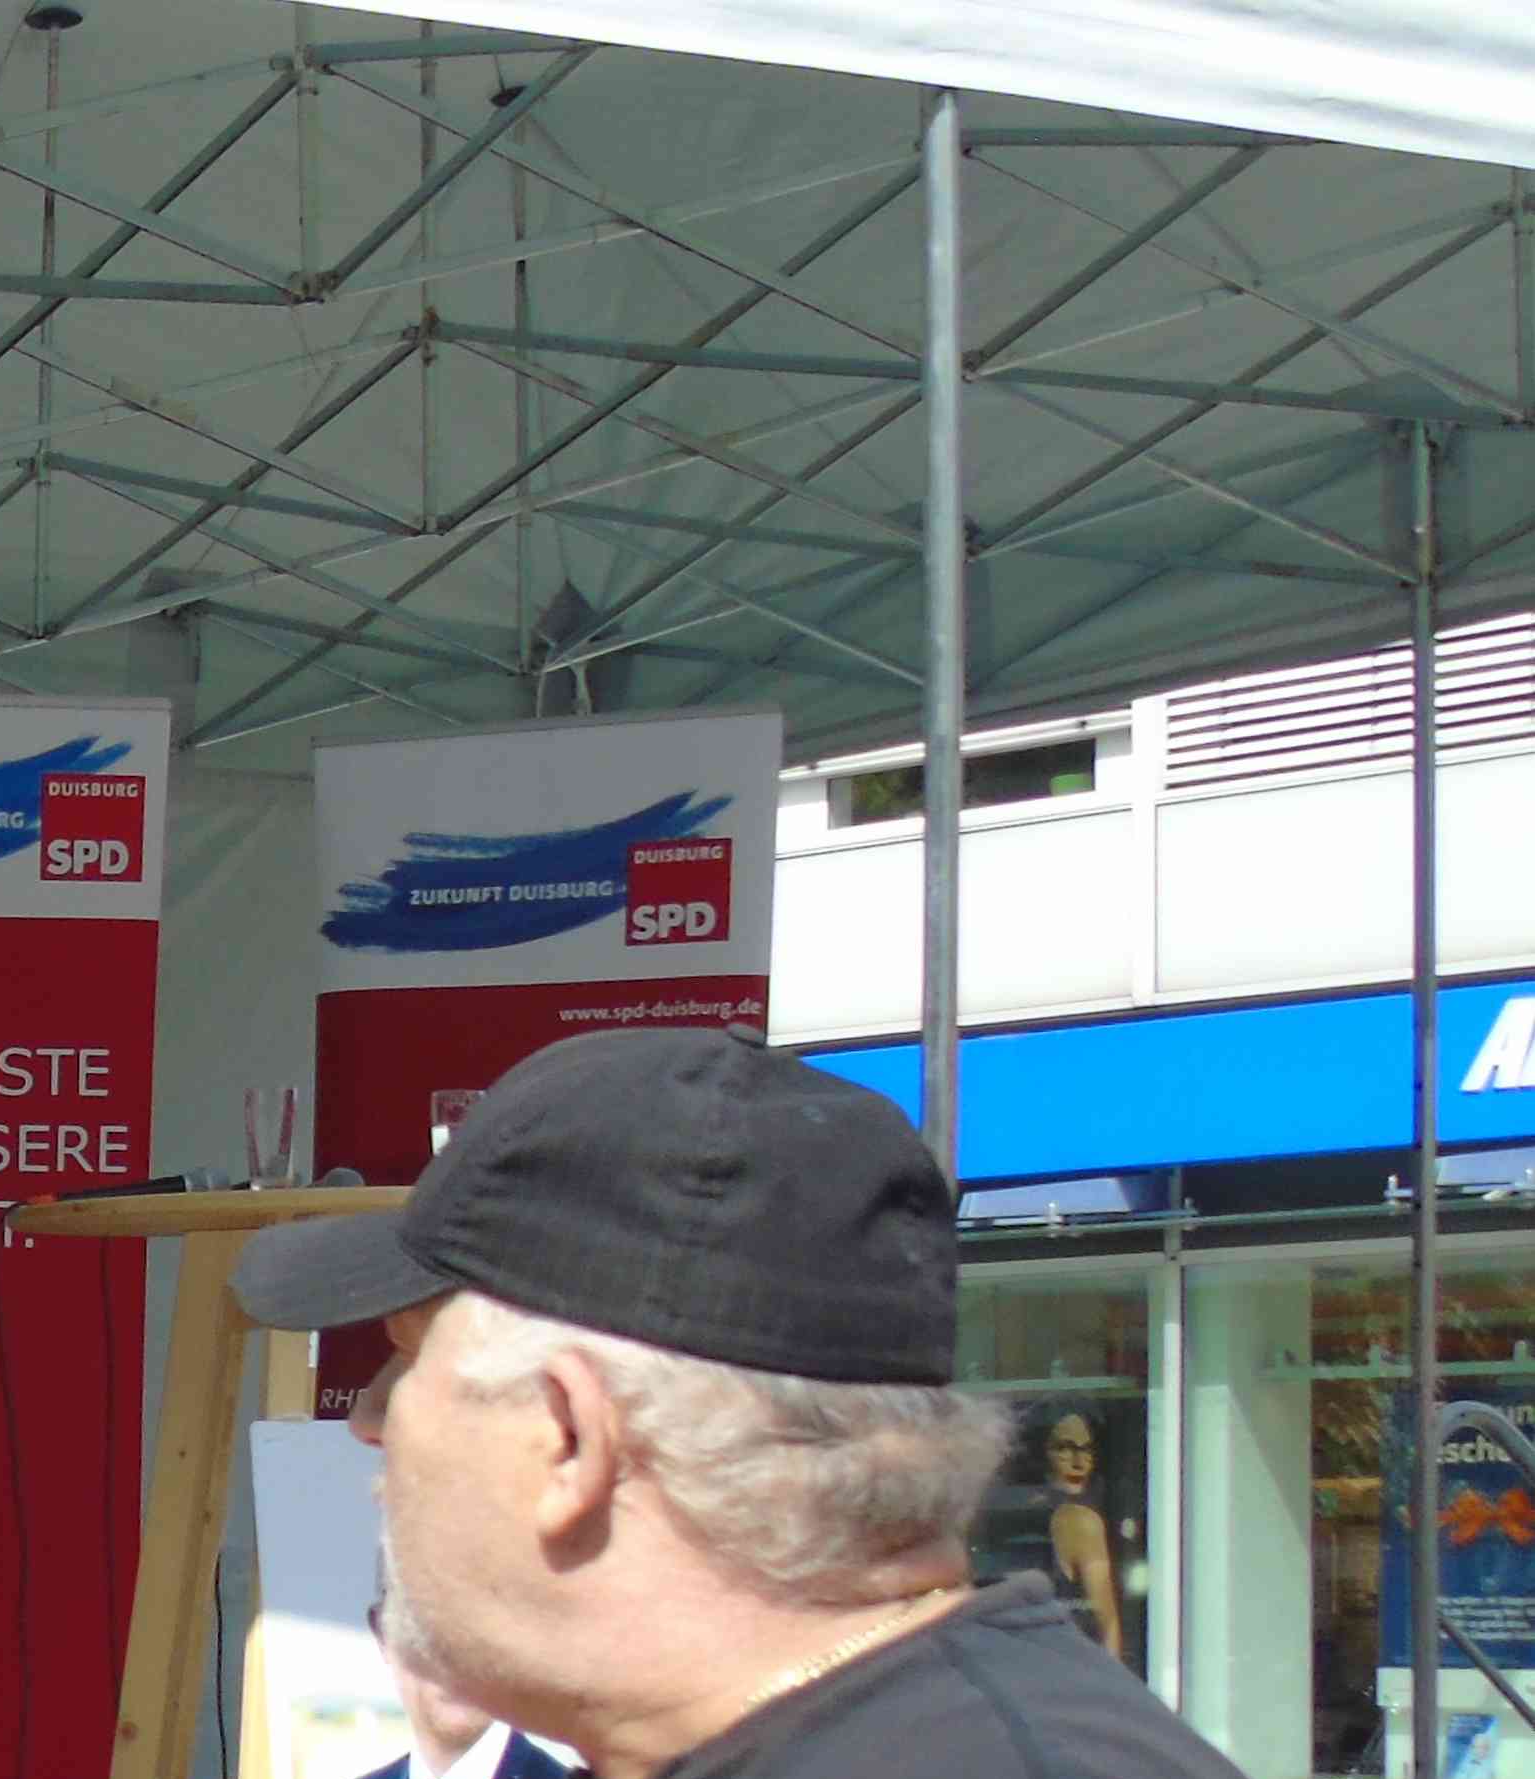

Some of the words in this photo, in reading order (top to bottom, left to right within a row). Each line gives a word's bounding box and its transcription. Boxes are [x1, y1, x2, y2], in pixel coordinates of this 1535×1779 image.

[48, 782, 139, 799] DUISBURG
[46, 839, 130, 876] SPD
[634, 845, 724, 864] DUISBURG
[410, 886, 503, 906] ZUKUNFT
[508, 880, 614, 902] DUISBURG
[632, 902, 716, 943] SPD
[559, 998, 763, 1023] www.spd-duisburg.de
